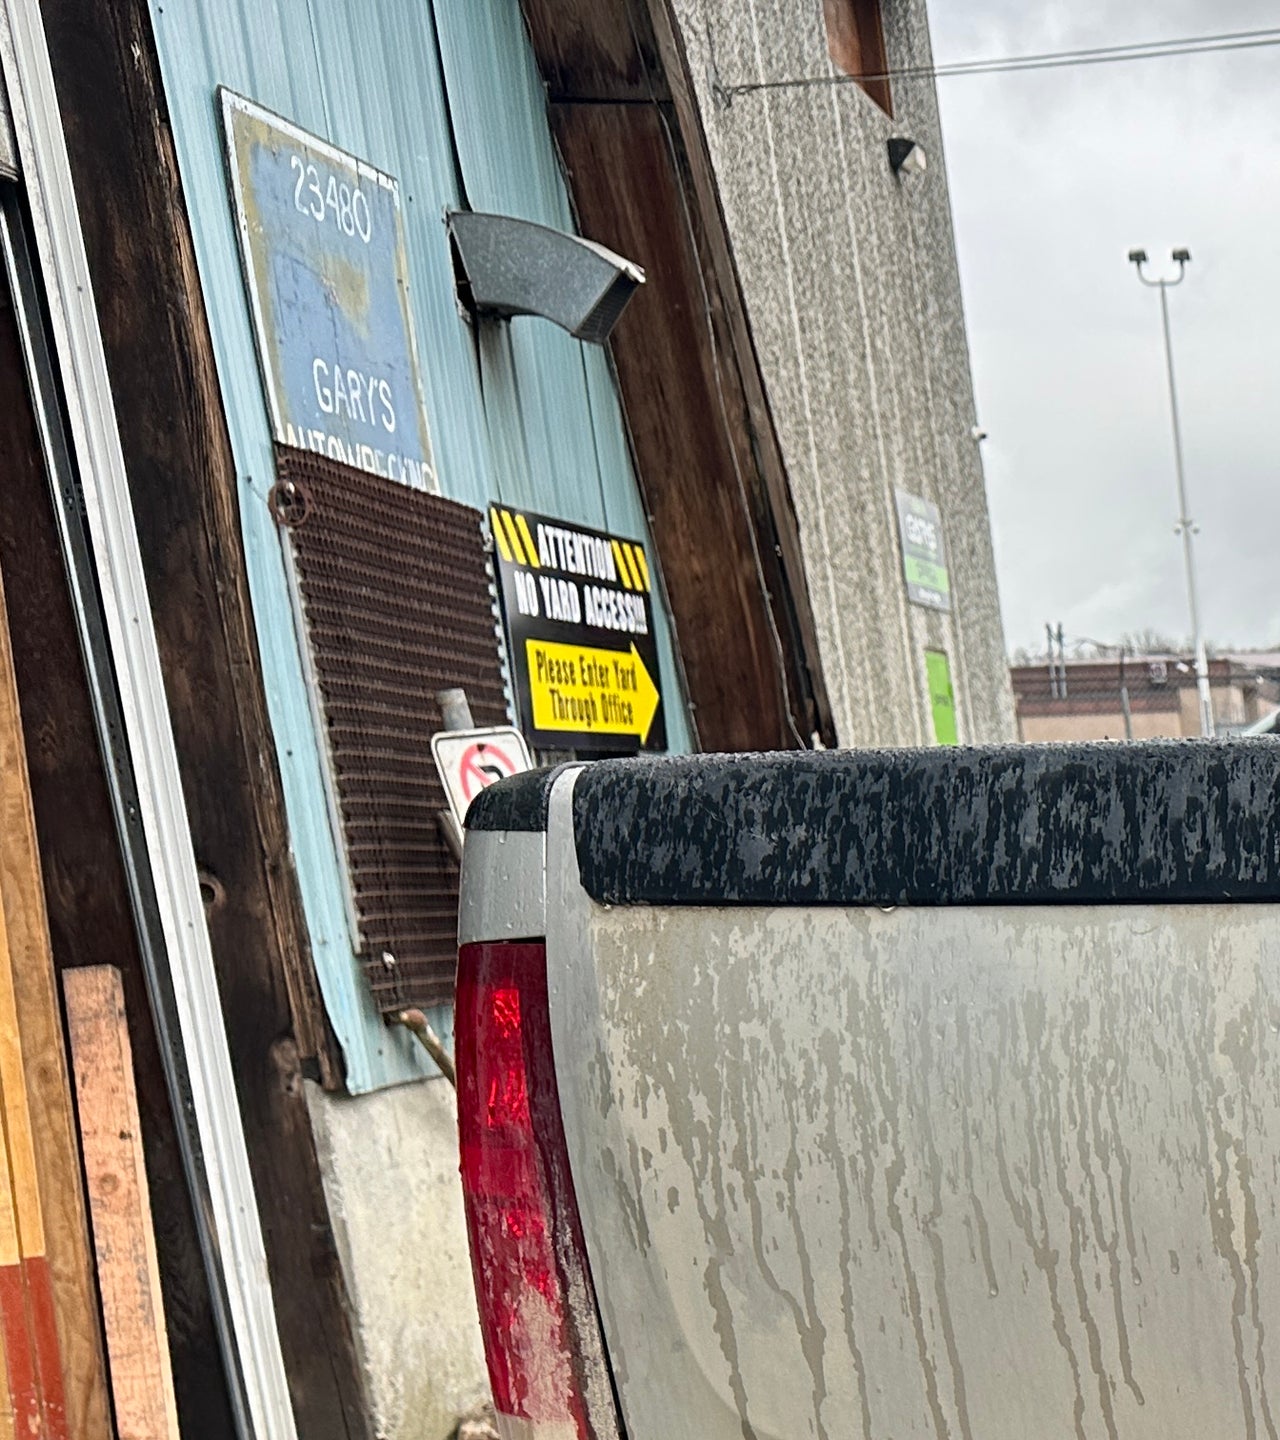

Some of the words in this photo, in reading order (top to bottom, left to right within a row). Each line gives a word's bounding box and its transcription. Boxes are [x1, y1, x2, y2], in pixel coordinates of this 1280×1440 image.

[291, 155, 371, 243] 23480
[312, 357, 396, 433] GARY'S
[536, 522, 617, 582] ATTENTION
[513, 570, 539, 617] NO
[539, 574, 581, 624] YARD
[535, 649, 577, 687] Please
[578, 654, 610, 690] Enter
[612, 657, 638, 693] Yard
[549, 687, 599, 728] Through
[600, 692, 634, 726] Office
